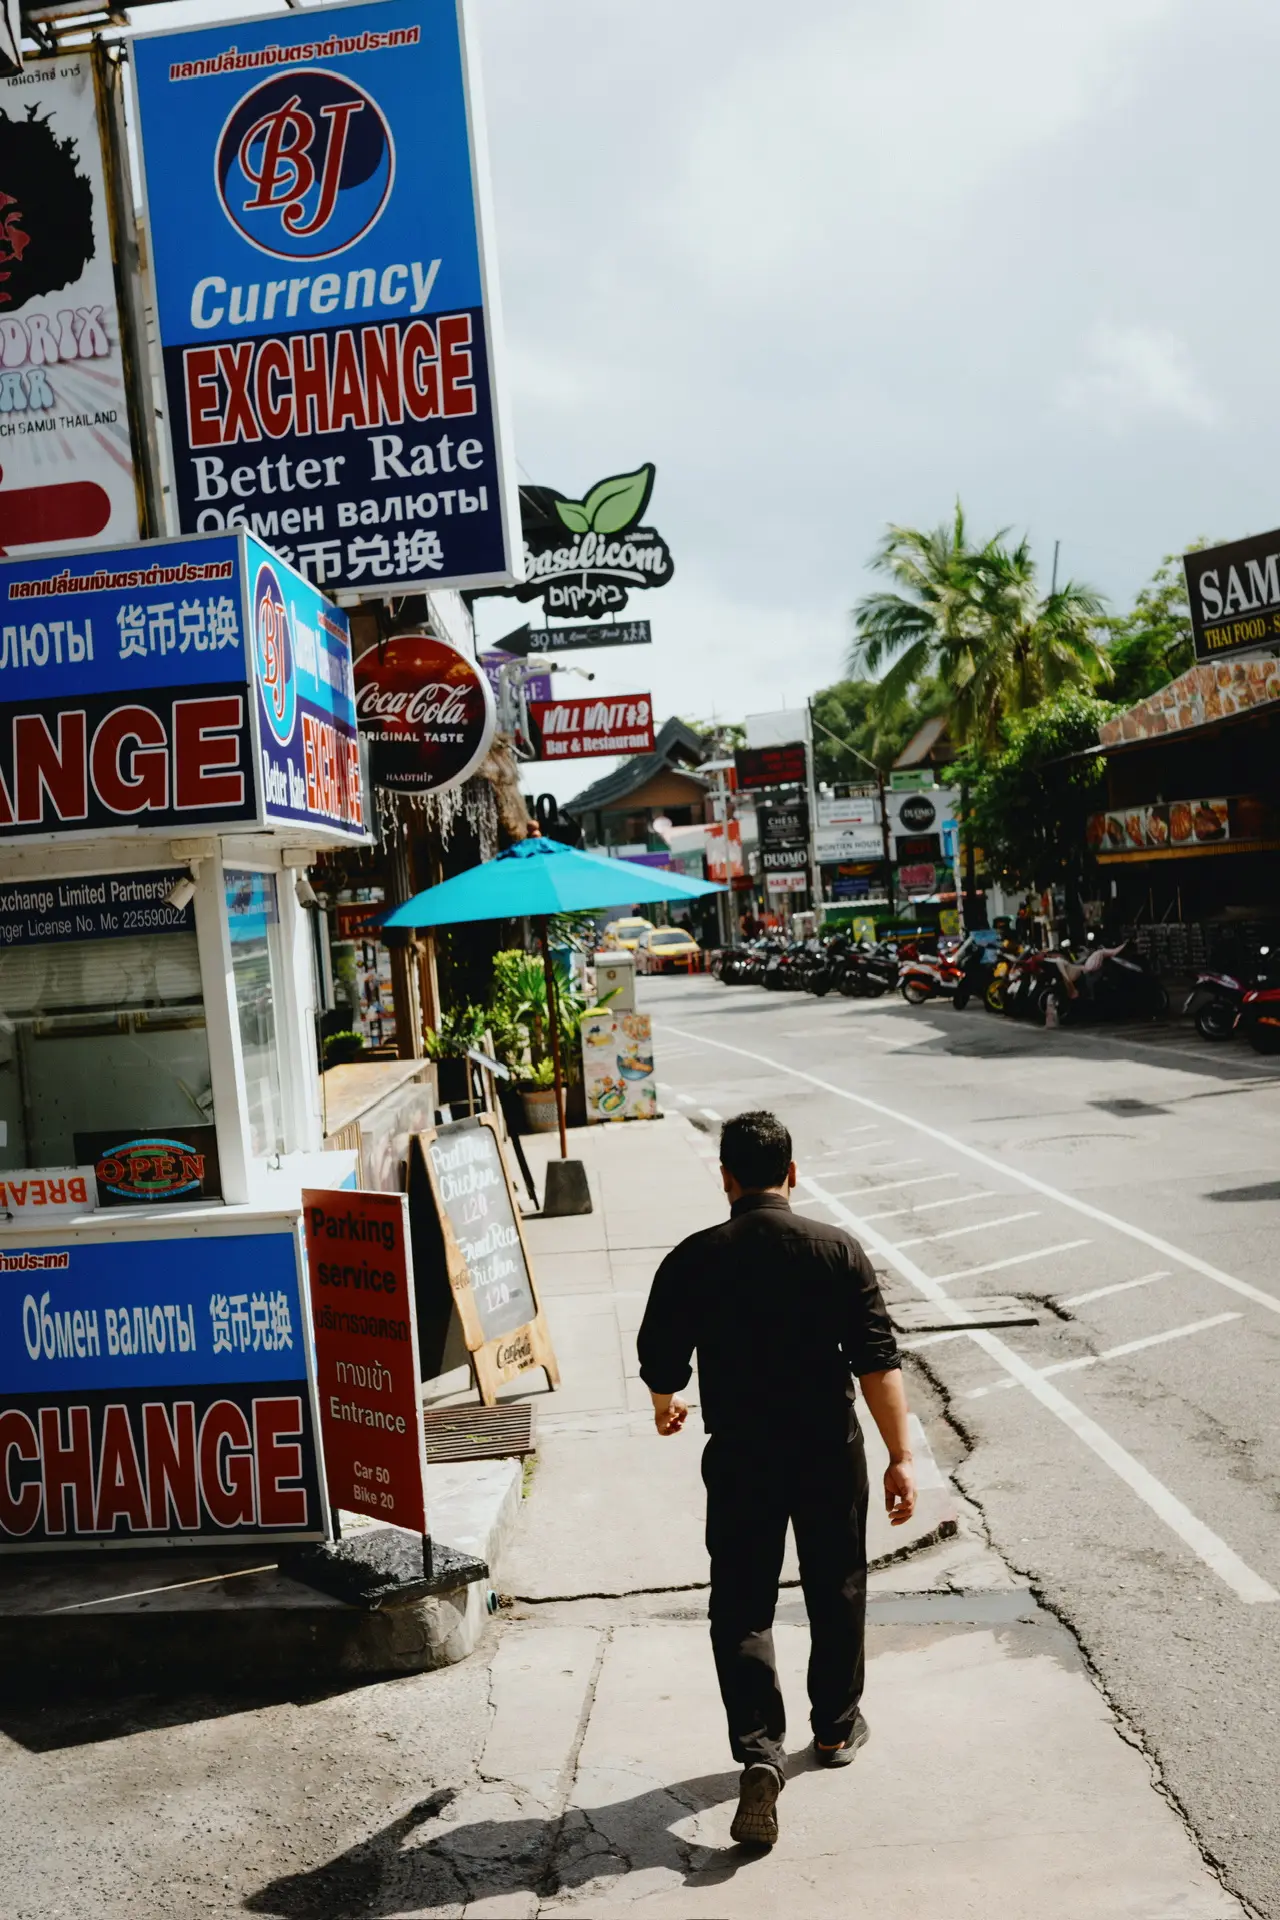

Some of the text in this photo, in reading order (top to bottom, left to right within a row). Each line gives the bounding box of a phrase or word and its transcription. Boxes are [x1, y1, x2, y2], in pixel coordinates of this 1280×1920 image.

[169, 25, 420, 82] แลกเปลี่ยนเงินตราต่างประเทศ
[238, 94, 365, 237] BJ
[190, 258, 443, 330] Currency
[183, 314, 476, 449] EXCHANGE
[18, 417, 56, 435] SAMUI
[60, 410, 118, 429] THAILAND
[190, 432, 485, 502] Better Rate
[337, 486, 488, 526] валюты
[9, 561, 234, 600] แลกเปลี่ยนเงินตราต่างประเทศ
[1199, 553, 1280, 621] SAM
[116, 595, 240, 659] 货币兑换
[1204, 625, 1232, 649] THAI
[1234, 618, 1266, 644] FOOD
[424, 733, 464, 743] TASTE
[546, 740, 568, 755] Bar
[583, 731, 649, 751] Restaurant
[0, 891, 54, 914] xchange
[58, 884, 105, 907] Limited
[28, 919, 72, 936] License
[76, 916, 96, 932] No.
[101, 913, 118, 930] Mc
[123, 908, 187, 929] 225590022
[96, 1155, 206, 1184] OPEN
[311, 1207, 395, 1250] Parking
[0, 1252, 69, 1272] ่างประเทศ
[318, 1260, 397, 1294] service
[22, 1291, 197, 1361] Обмен валюты
[209, 1291, 294, 1355] 货币兑换
[336, 1360, 393, 1393] ทางเข้า
[329, 1396, 406, 1434] Entrance
[0, 1396, 308, 1537] CHANGE
[354, 1461, 390, 1485] Car 50
[354, 1484, 395, 1510] Bike 20
